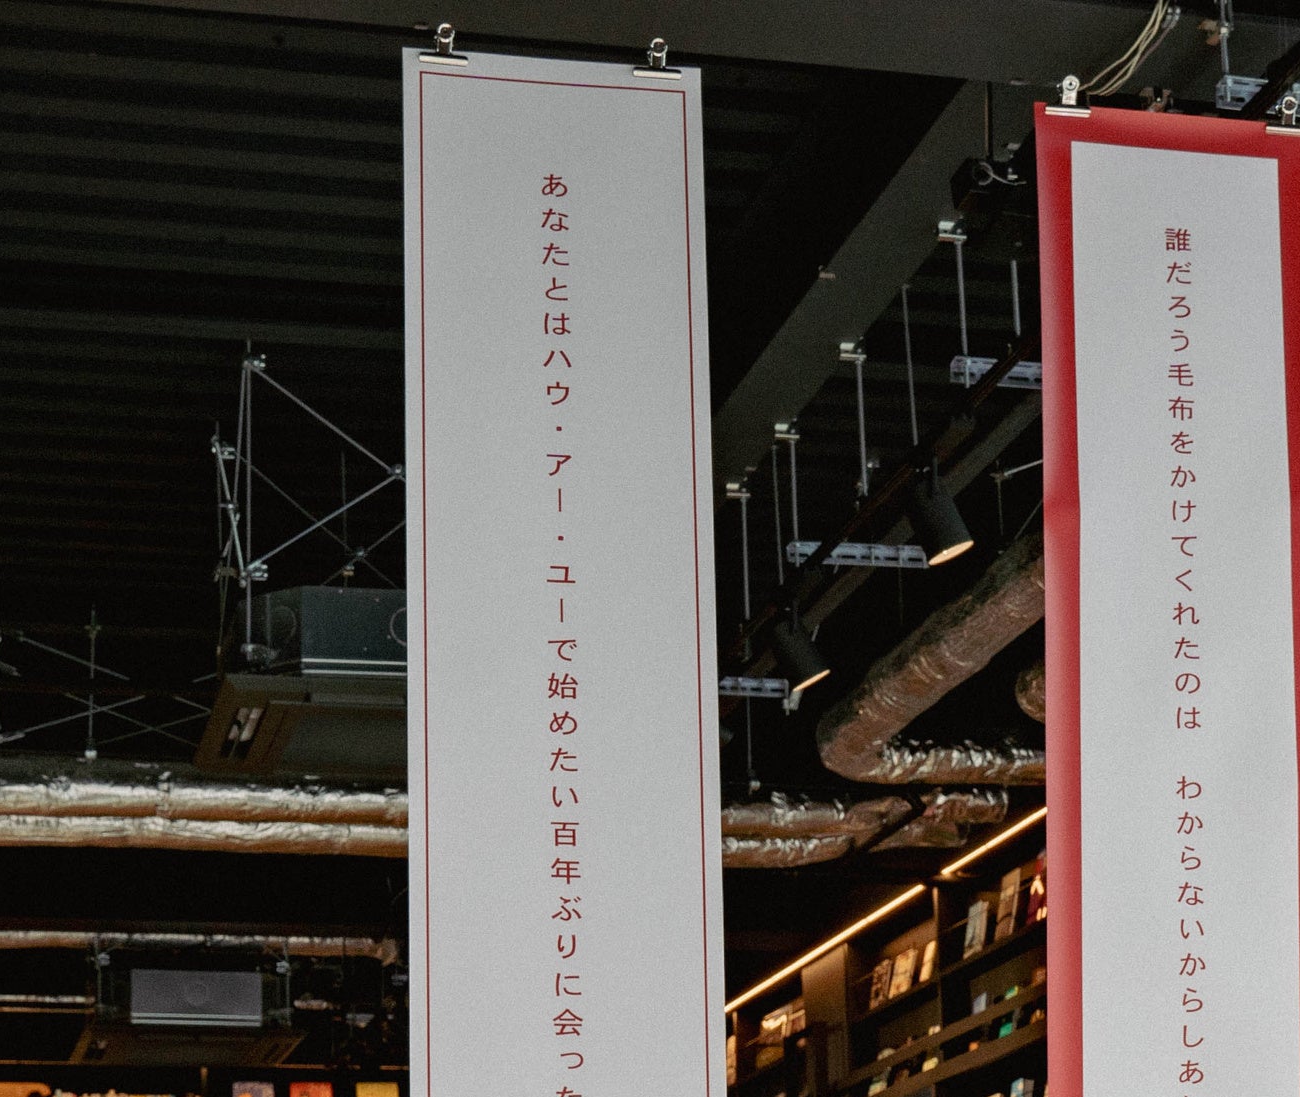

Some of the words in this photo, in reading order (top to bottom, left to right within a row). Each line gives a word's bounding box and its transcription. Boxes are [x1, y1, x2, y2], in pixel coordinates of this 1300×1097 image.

[1164, 227, 1202, 730] 誰だろう毛布をかけてくれたのは
